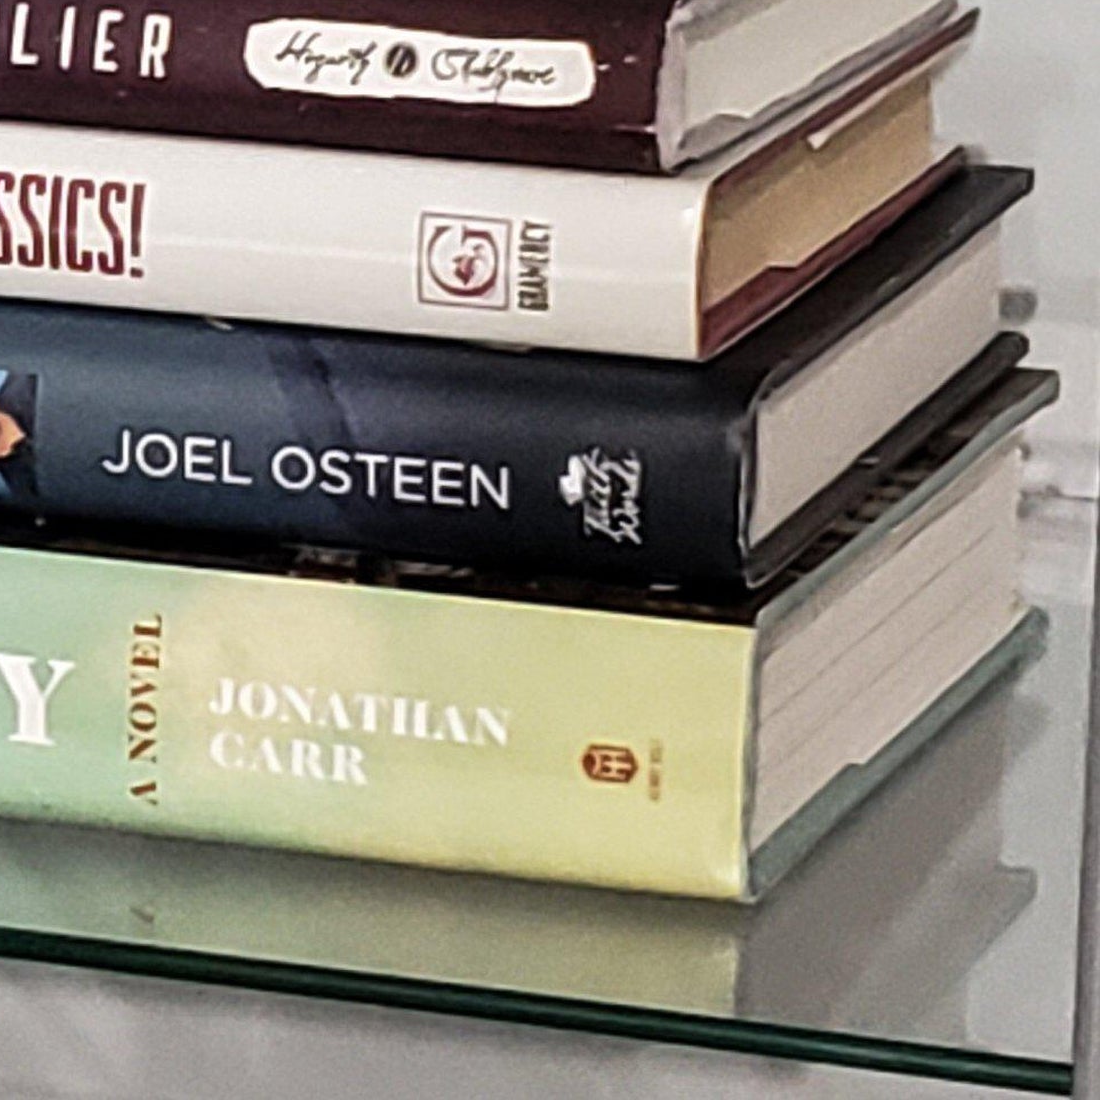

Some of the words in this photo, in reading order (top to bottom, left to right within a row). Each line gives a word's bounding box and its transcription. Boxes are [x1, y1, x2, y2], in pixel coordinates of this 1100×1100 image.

[102, 430, 253, 486] JOEL
[271, 445, 510, 510] OSTEEN
[128, 613, 163, 764] NOVEL
[209, 677, 511, 747] JONATHAN
[209, 728, 368, 786] CARR
[129, 781, 158, 806] A
